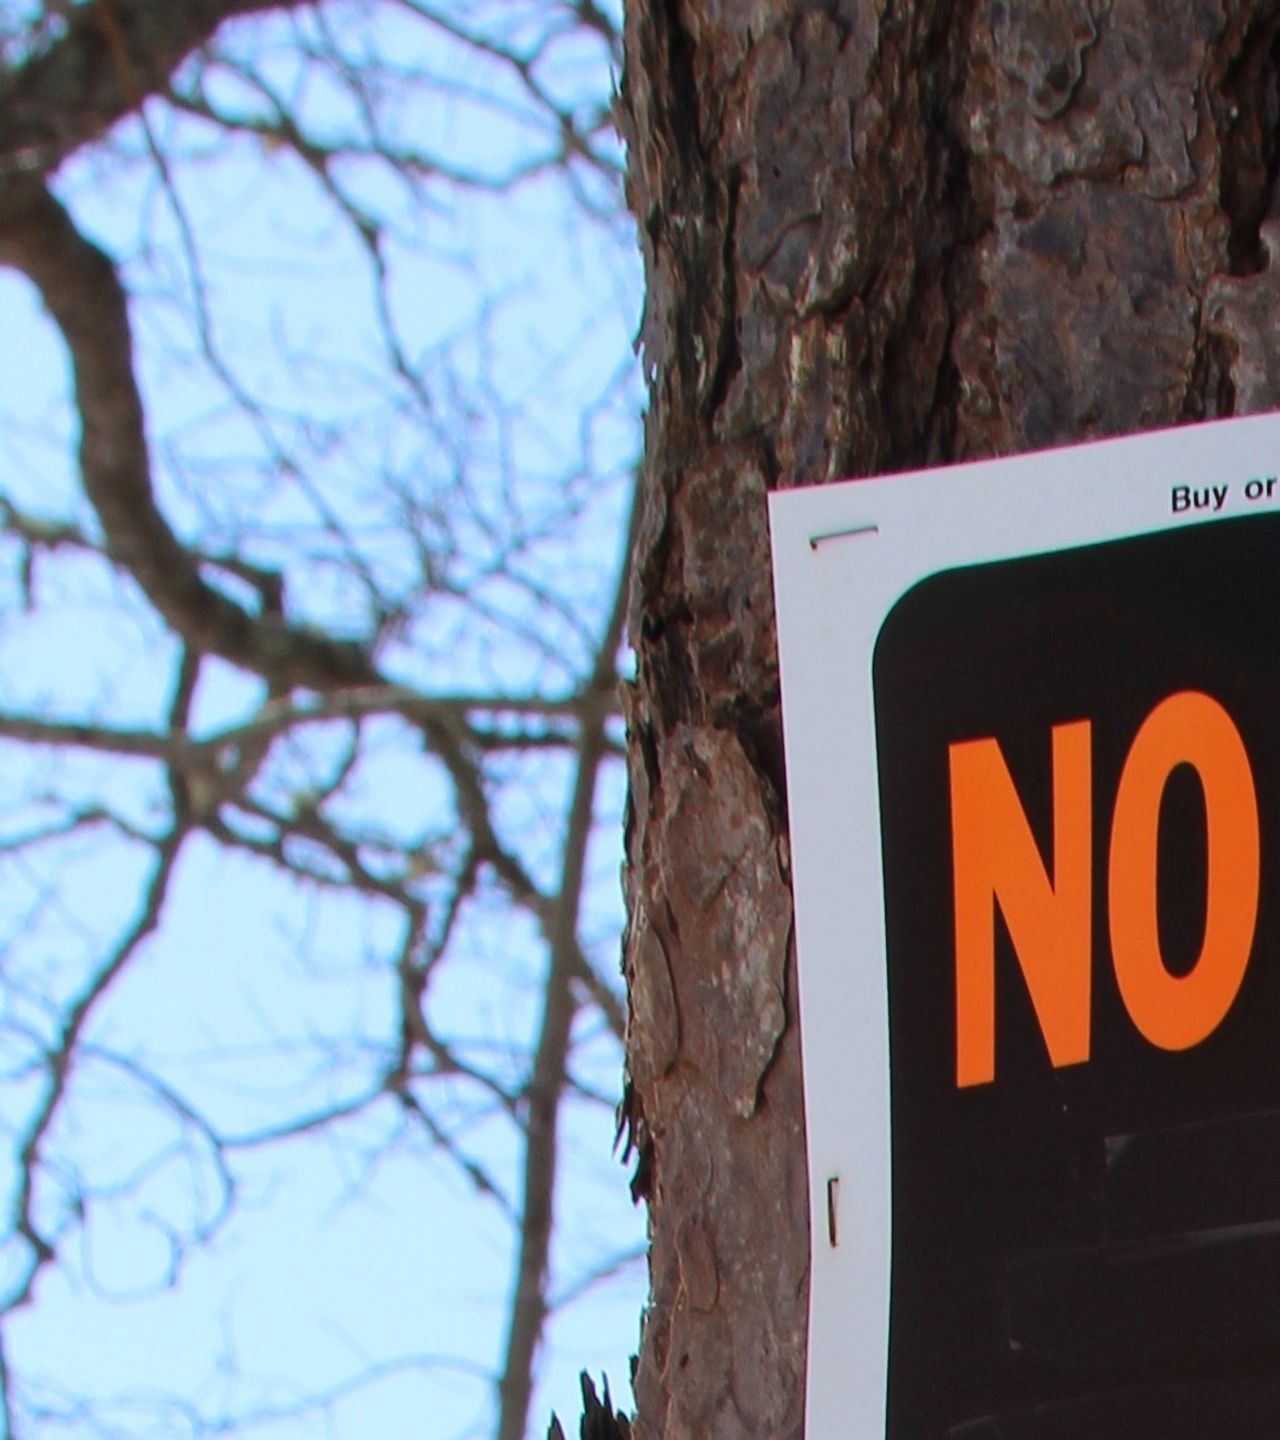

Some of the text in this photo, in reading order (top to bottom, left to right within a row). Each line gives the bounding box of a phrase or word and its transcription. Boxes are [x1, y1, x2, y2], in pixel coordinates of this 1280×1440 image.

[1171, 486, 1228, 512] Buy
[1245, 477, 1277, 499] or
[948, 691, 1260, 1089] NO
